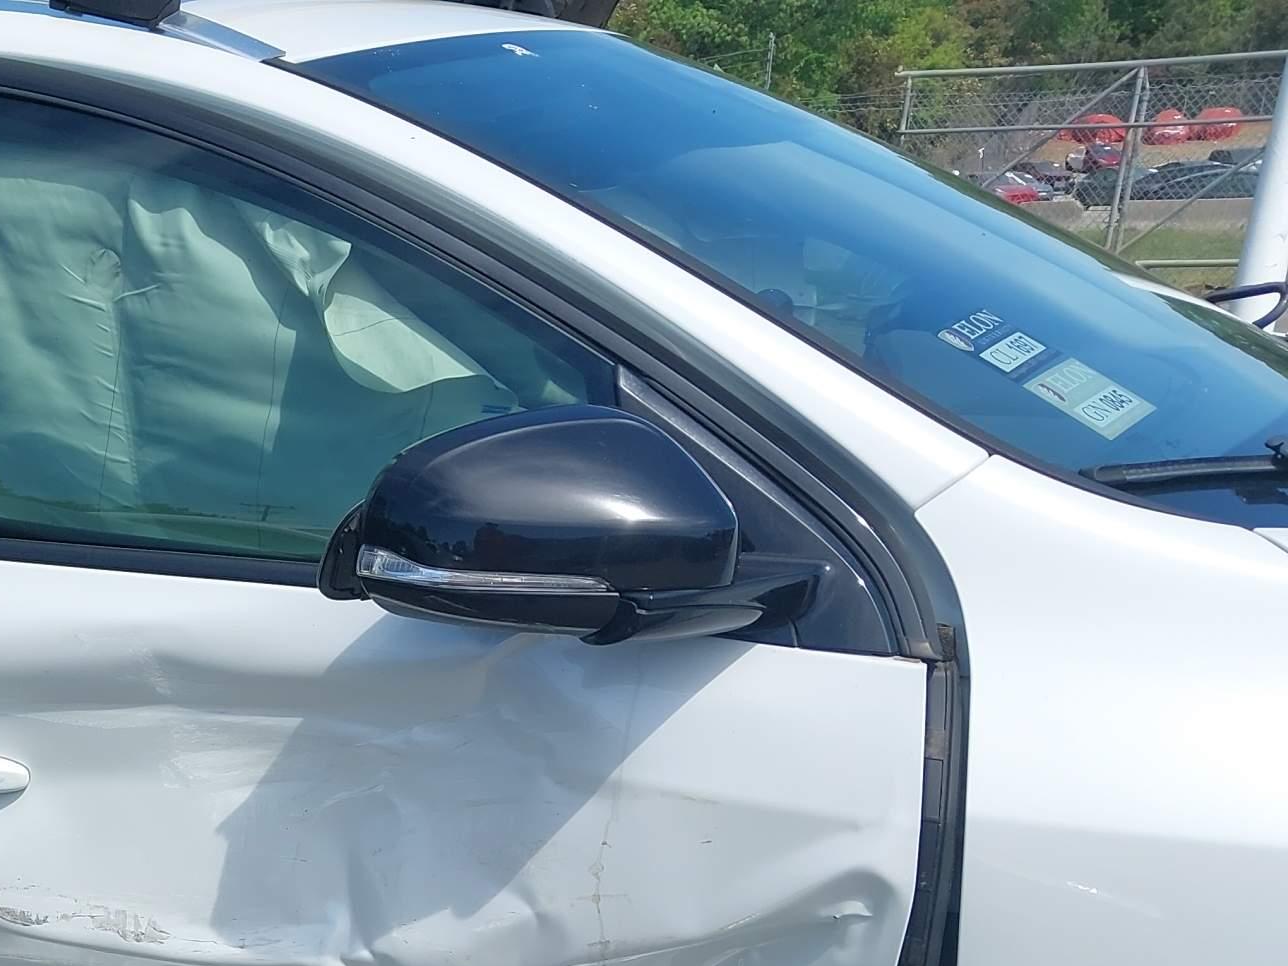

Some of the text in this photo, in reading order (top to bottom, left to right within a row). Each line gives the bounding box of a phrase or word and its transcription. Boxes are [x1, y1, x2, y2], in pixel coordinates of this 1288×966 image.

[952, 309, 1004, 340] ELON
[990, 335, 1039, 365] CL 1697
[1081, 389, 1133, 422] GN 0845
